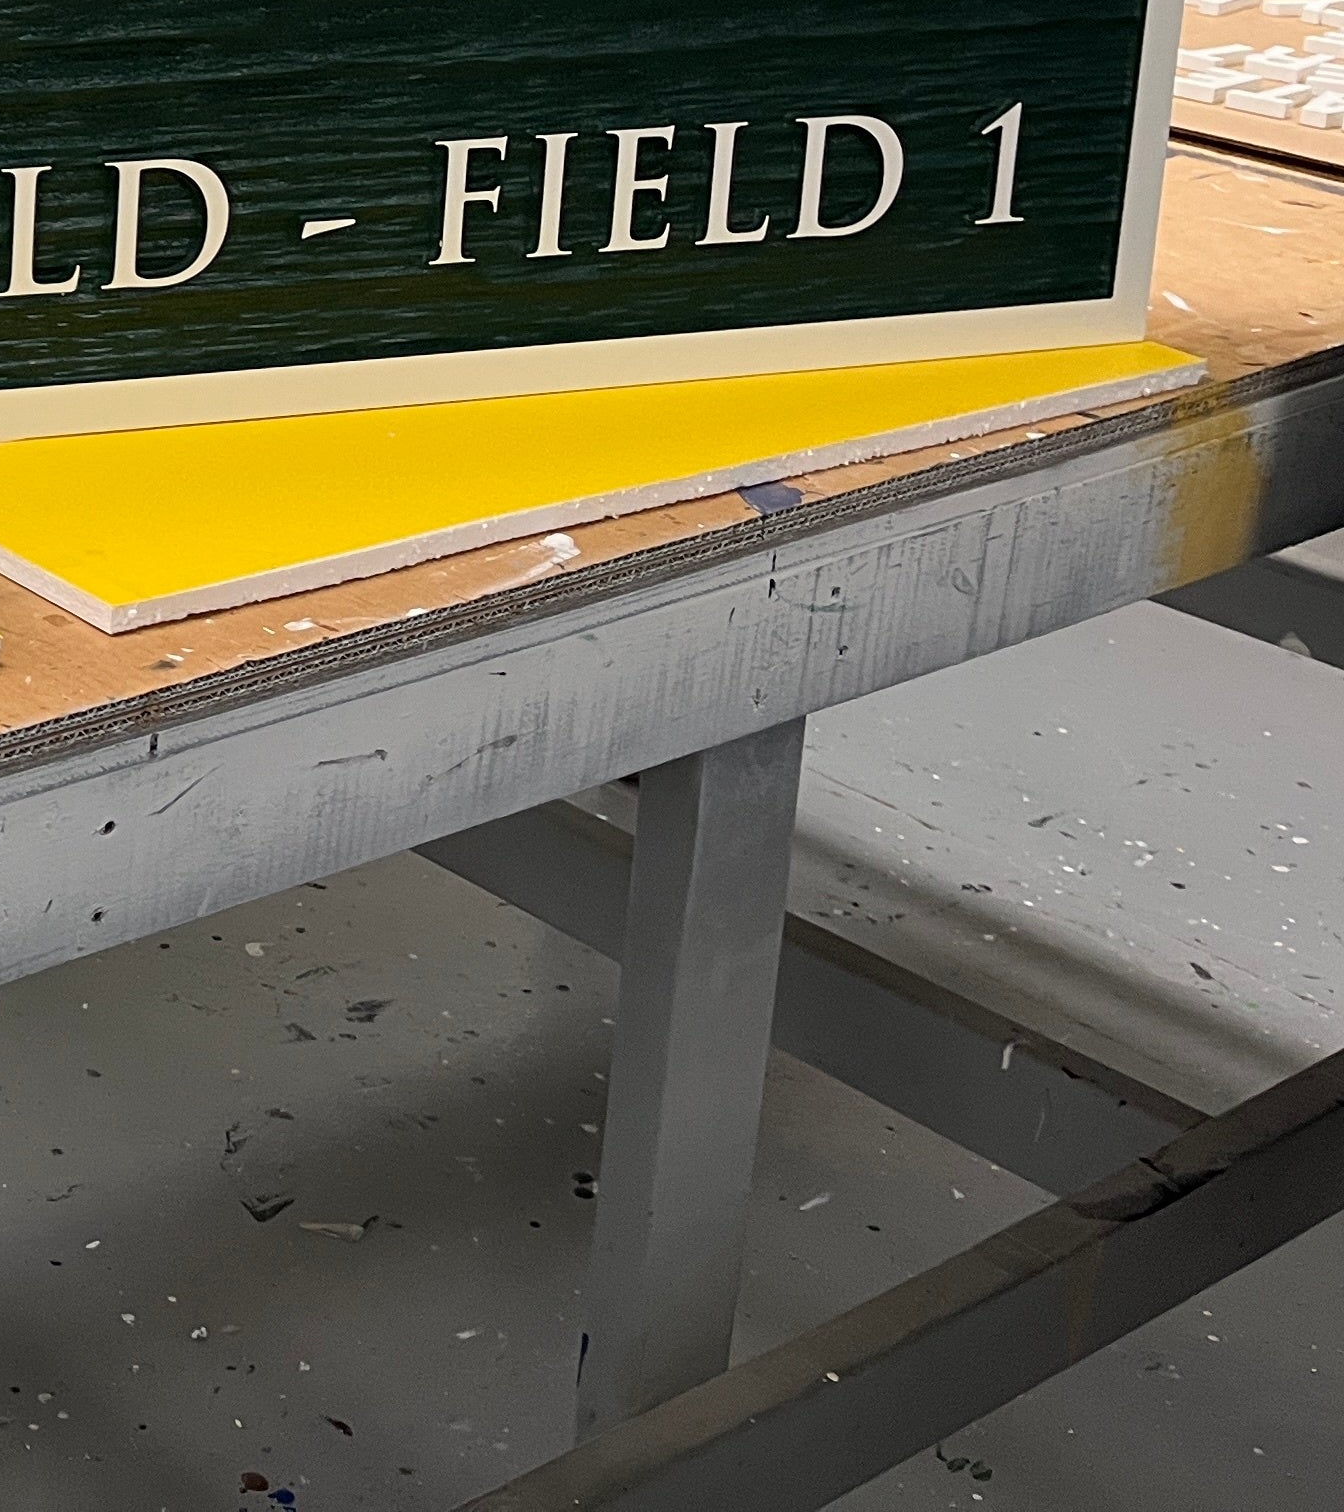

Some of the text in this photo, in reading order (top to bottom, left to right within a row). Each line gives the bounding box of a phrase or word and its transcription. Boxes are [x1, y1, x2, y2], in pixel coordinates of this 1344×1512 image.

[300, 217, 358, 241] -
[428, 115, 905, 267] FIELD
[974, 102, 1025, 225] 1
